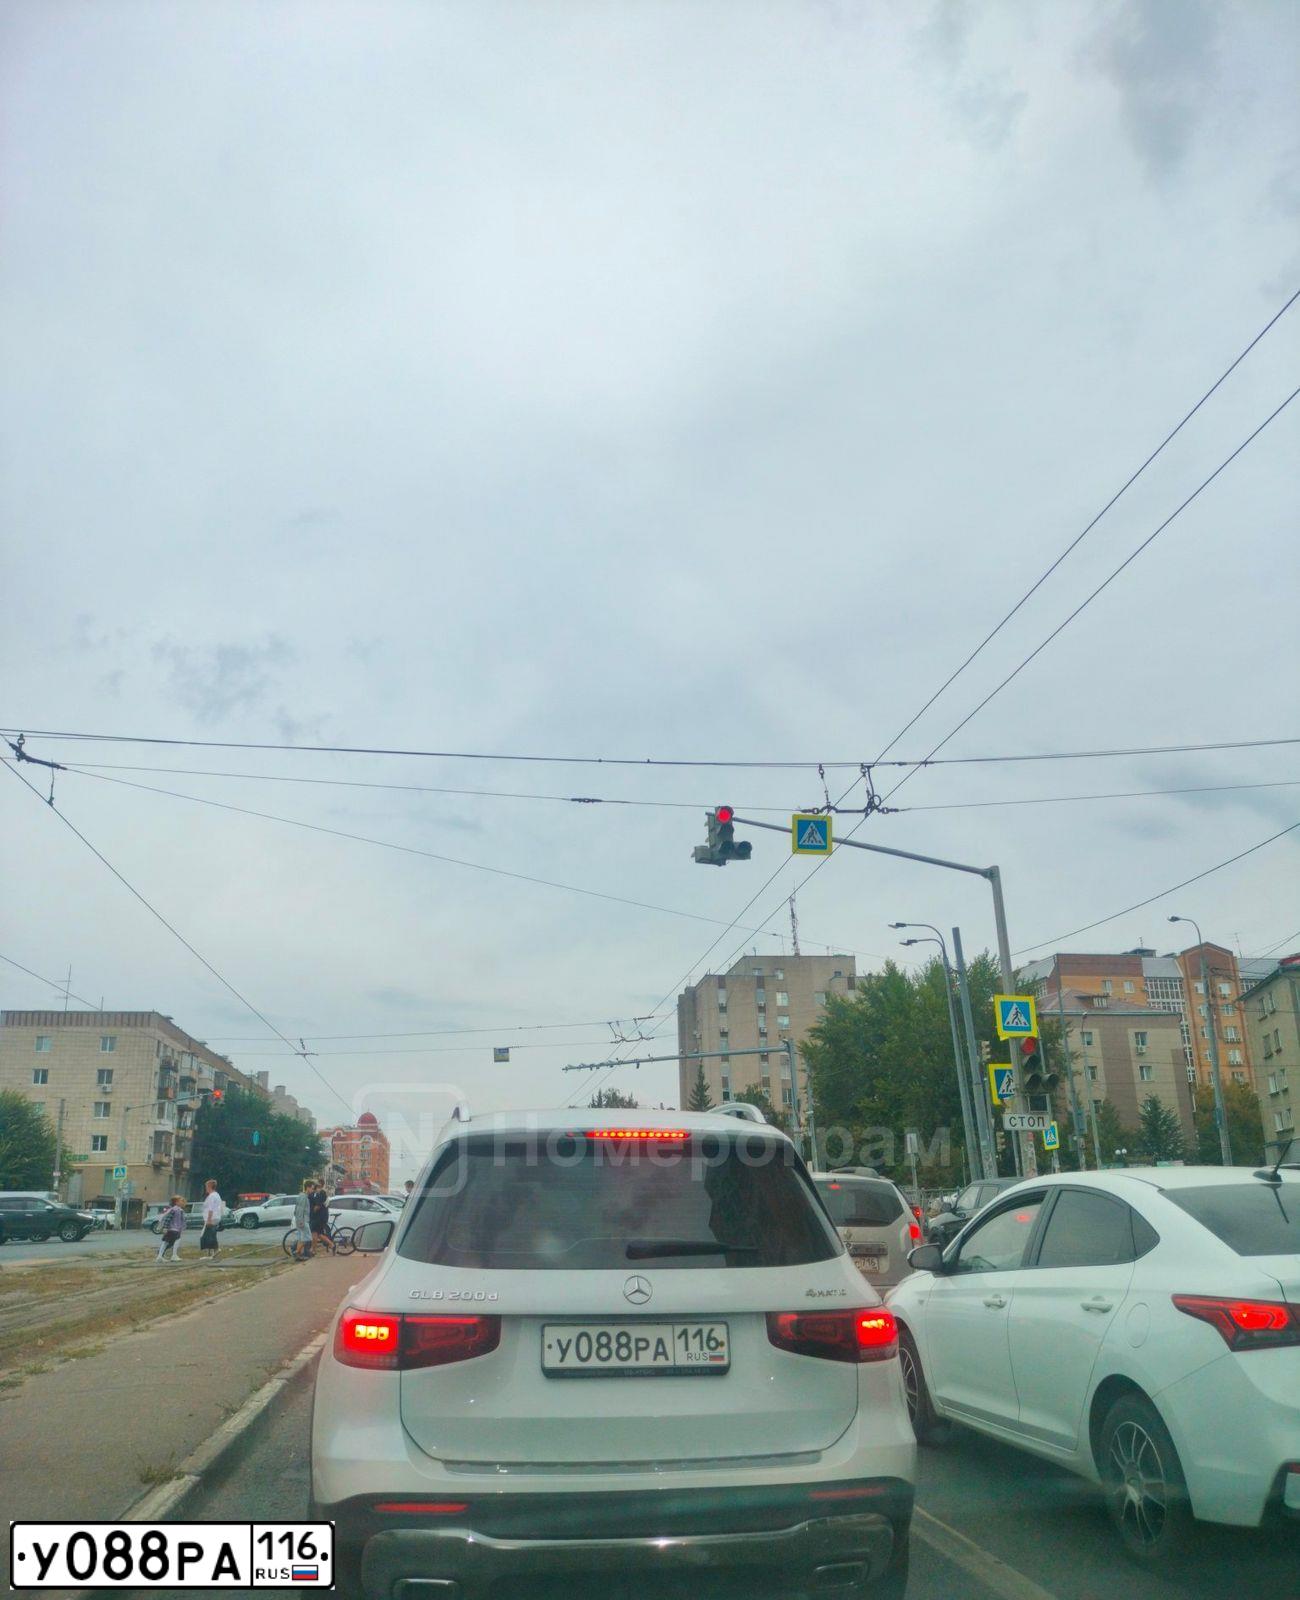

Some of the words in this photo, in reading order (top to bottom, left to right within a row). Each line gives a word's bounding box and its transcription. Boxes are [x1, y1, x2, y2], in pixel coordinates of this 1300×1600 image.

[1009, 1116, 1045, 1128] СТОП
[408, 1289, 444, 1300] GLB
[677, 1328, 719, 1352] 116
[686, 1352, 708, 1362] RUS
